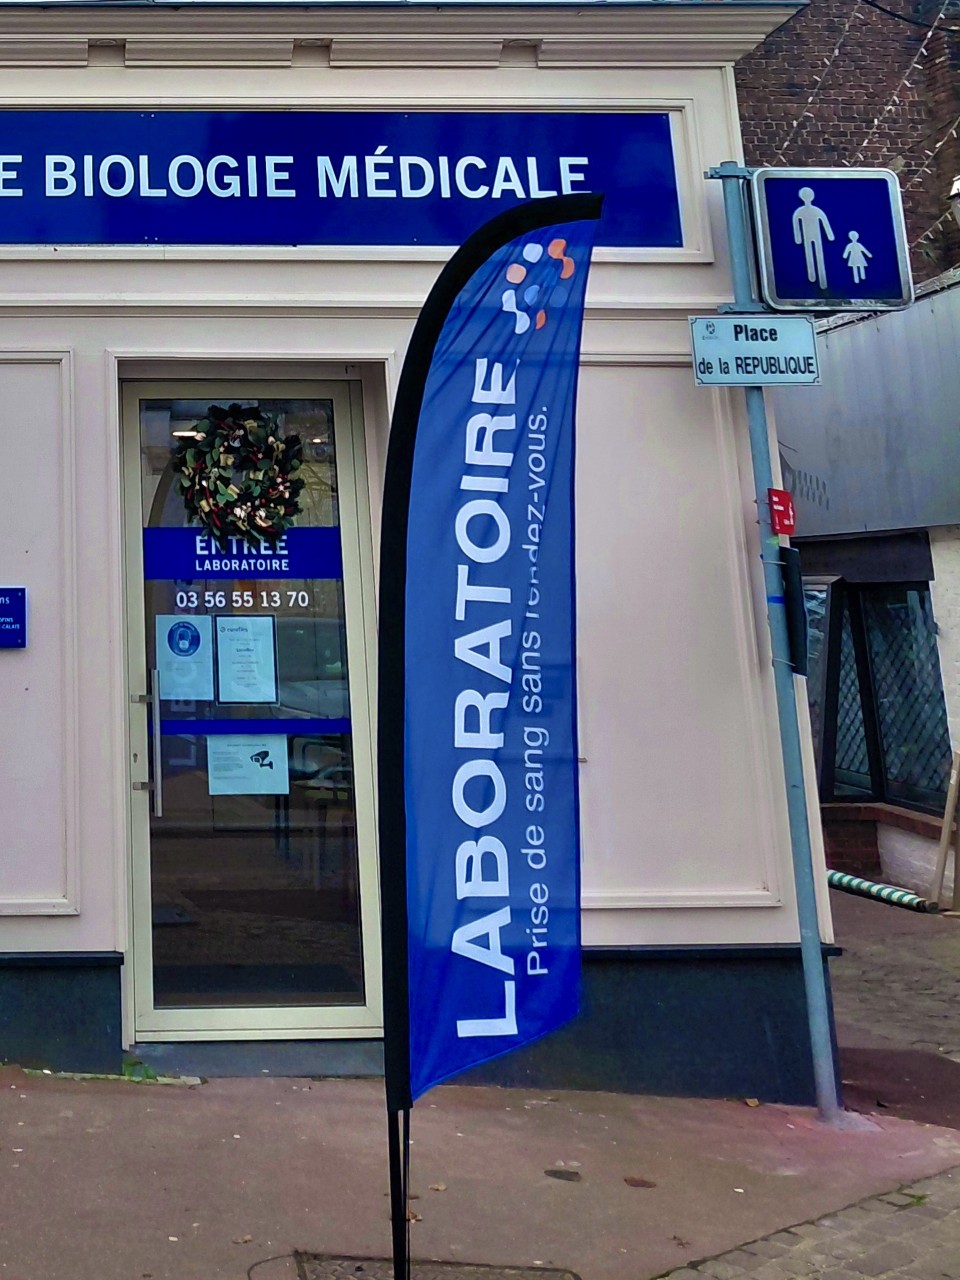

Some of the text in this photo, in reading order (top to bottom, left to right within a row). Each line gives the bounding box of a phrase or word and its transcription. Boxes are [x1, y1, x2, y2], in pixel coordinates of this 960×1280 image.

[43, 153, 296, 198] BIOLOGIE
[316, 145, 593, 198] MÉDICALE
[733, 324, 778, 342] Place
[698, 356, 816, 375] de la REPUBLIQUE
[195, 559, 290, 571] LABORATOIRE
[176, 591, 309, 608] 03 56 55 13 70
[522, 630, 543, 713] sans
[451, 357, 520, 1038] LABORATOIRE
[524, 726, 549, 812] sang
[520, 824, 545, 870] de
[526, 882, 549, 975] Prise
